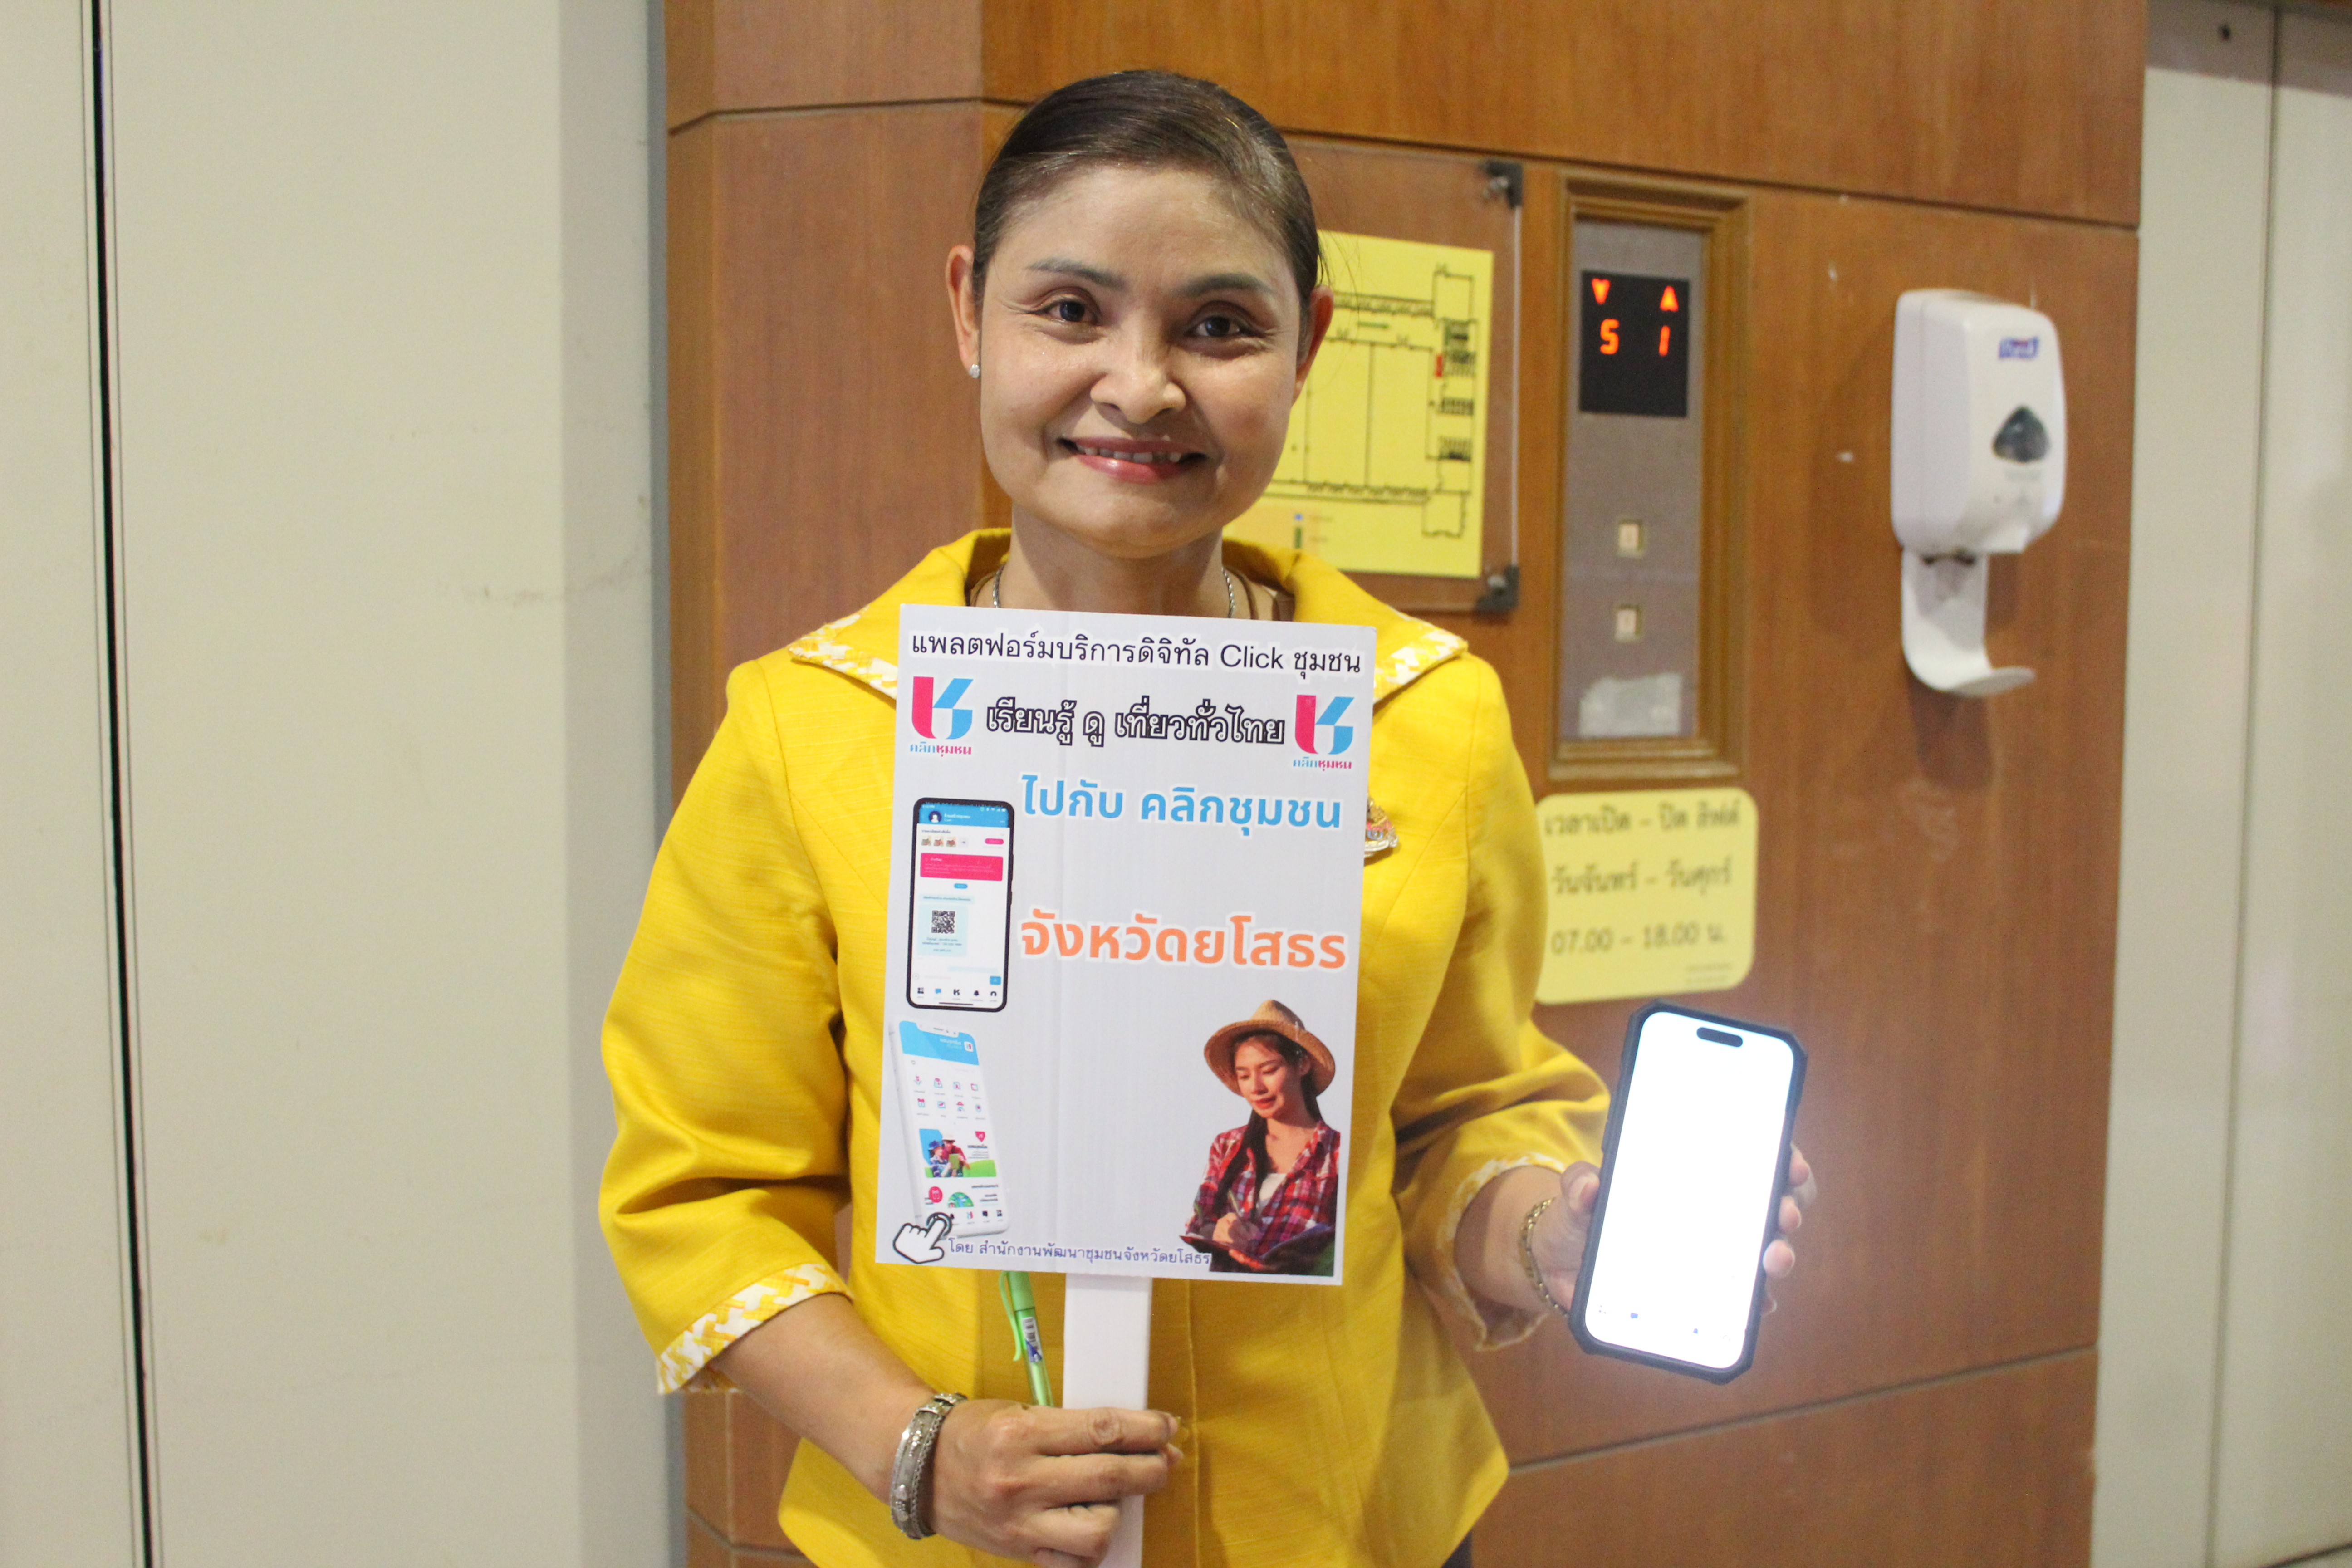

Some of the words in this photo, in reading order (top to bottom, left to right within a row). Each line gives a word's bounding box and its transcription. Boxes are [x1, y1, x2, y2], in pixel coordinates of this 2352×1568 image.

[1600, 318, 1619, 354] 5
[913, 631, 1208, 665] แพลตฟอร์มบริการดิจิทัล
[1221, 645, 1283, 668] Click
[1294, 652, 1360, 679] ชุมชน
[987, 697, 1077, 746] เรียนรู้
[1083, 711, 1105, 747] ดู
[1115, 695, 1285, 744] เที่ยวทั่วไทย
[1022, 775, 1122, 818] ไปกับ
[1142, 787, 1340, 836] คลิกชุมชน
[1022, 909, 1345, 969] จังหวัดยโสธร
[949, 1238, 972, 1254] โดย
